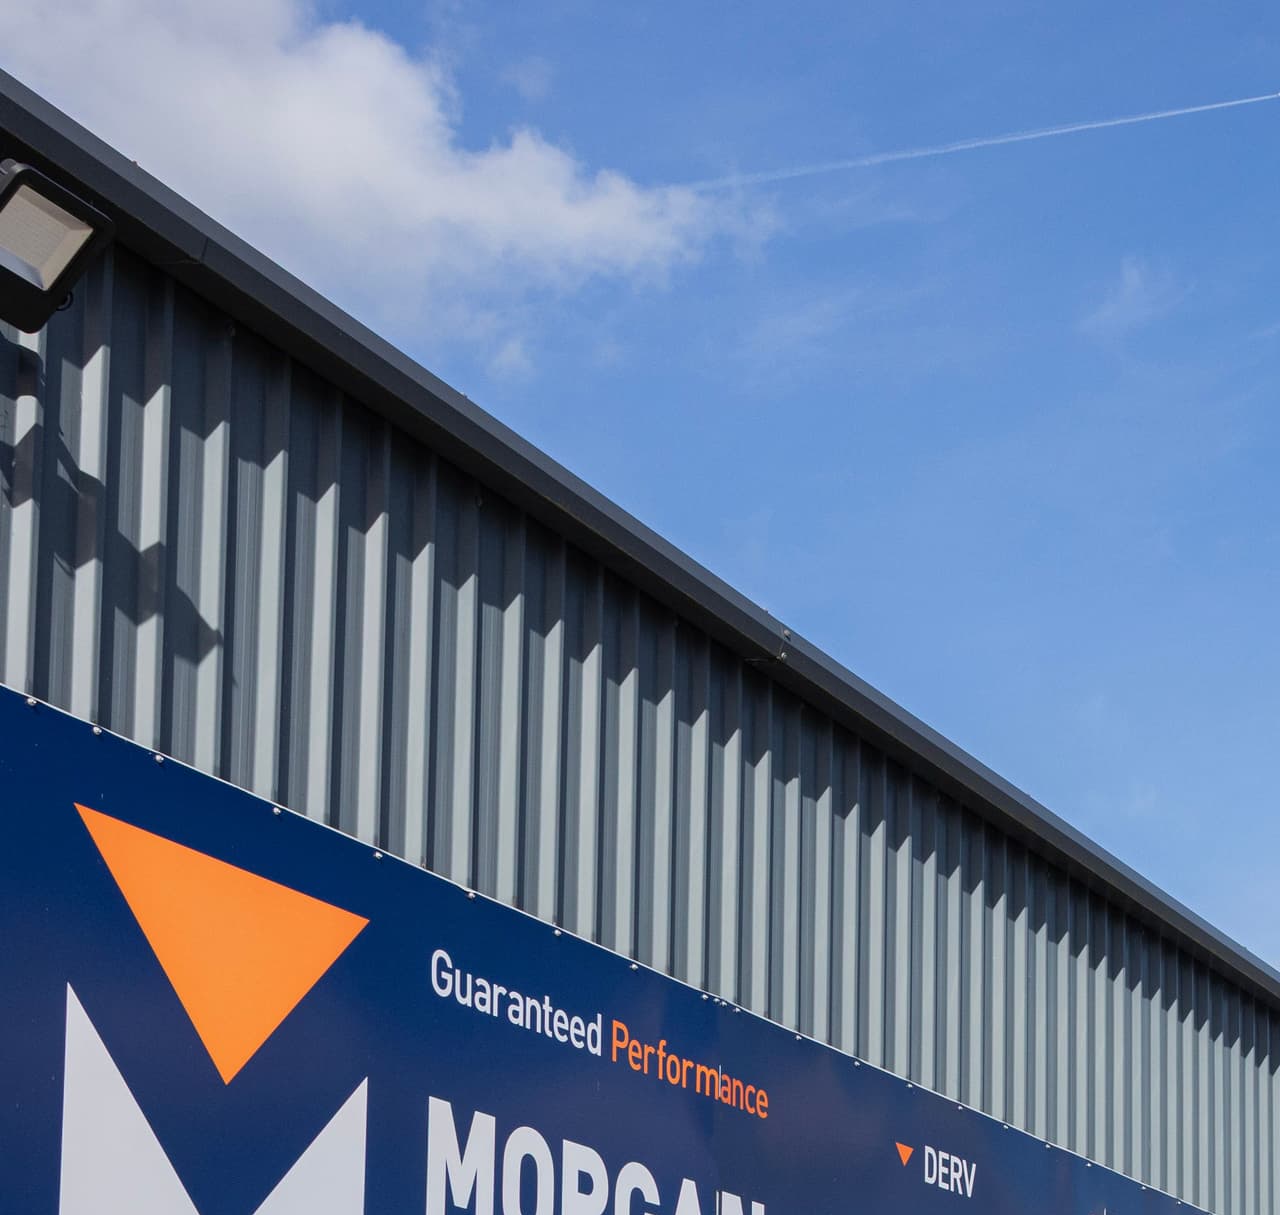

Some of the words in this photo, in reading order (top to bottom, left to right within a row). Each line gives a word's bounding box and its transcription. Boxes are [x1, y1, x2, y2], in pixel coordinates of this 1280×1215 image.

[430, 948, 602, 1057] Guaranteed
[611, 1019, 769, 1119] Performance
[924, 1145, 977, 1198] DERV
